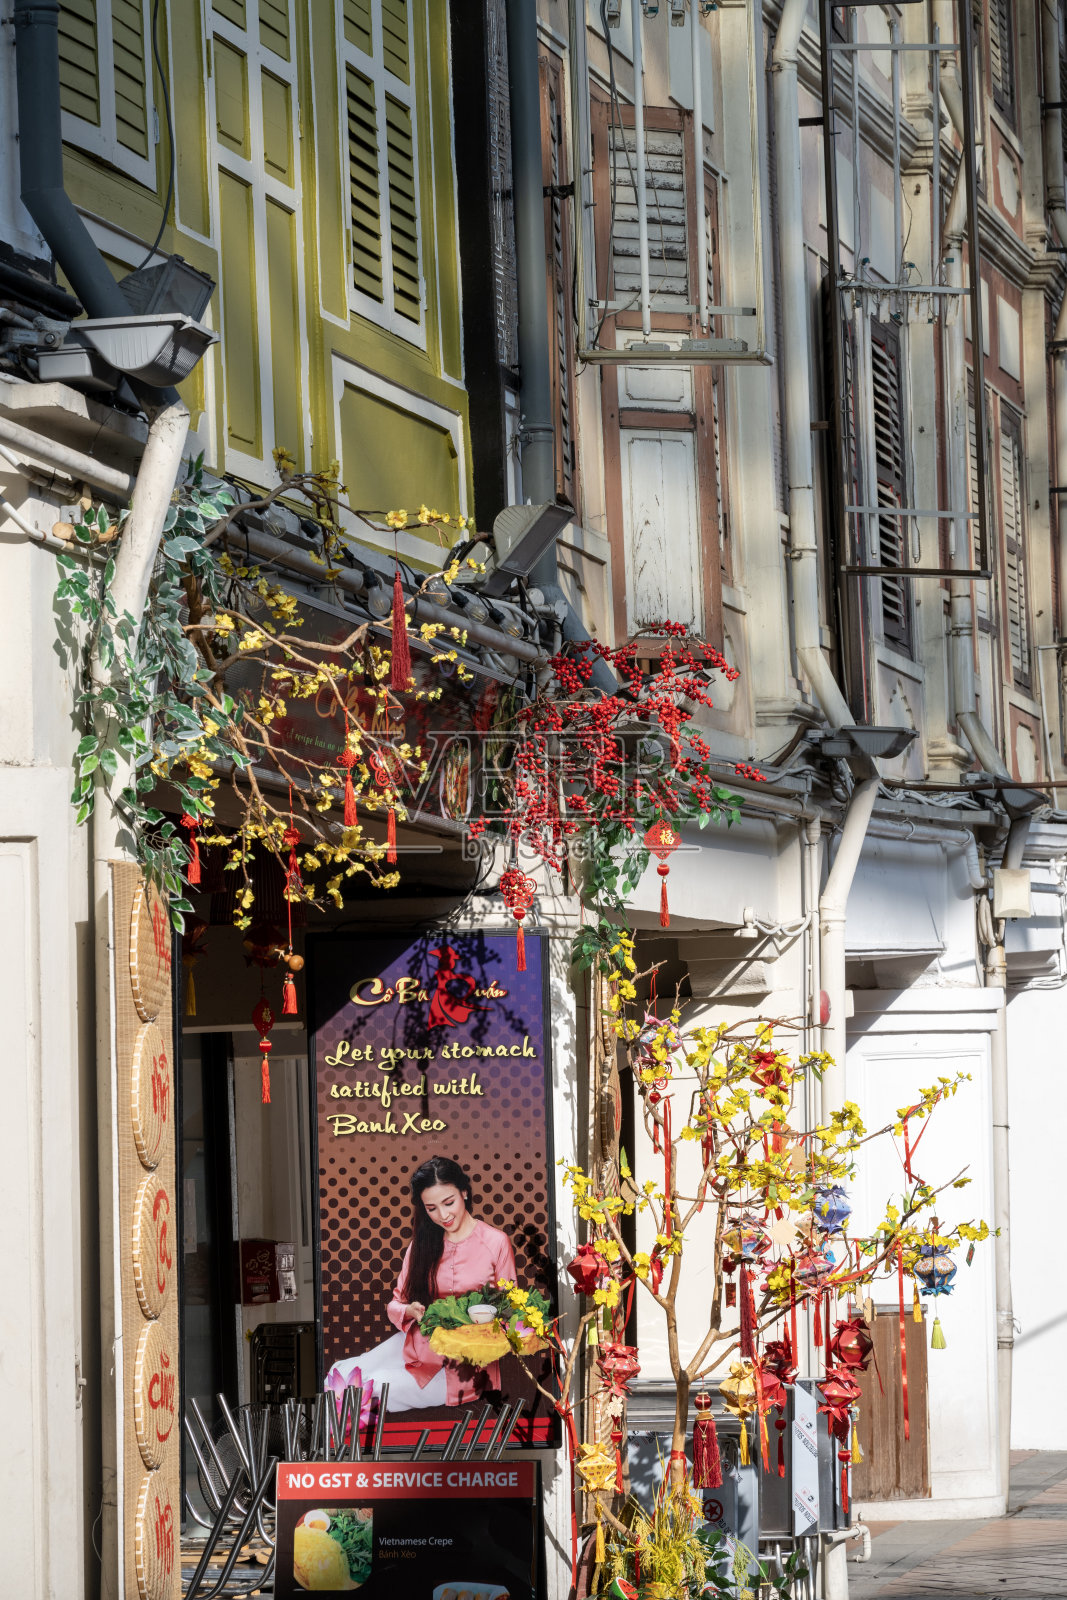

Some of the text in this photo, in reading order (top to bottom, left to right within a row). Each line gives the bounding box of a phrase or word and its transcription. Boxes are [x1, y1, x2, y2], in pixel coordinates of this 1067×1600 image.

[395, 977, 430, 1004] Ba
[324, 1035, 537, 1071] Let your stomach
[330, 1072, 484, 1108] satisfied with
[288, 1471, 519, 1489] NO GST & SERVICE CHARGE
[378, 1536, 453, 1548] Vietnamese Crepe
